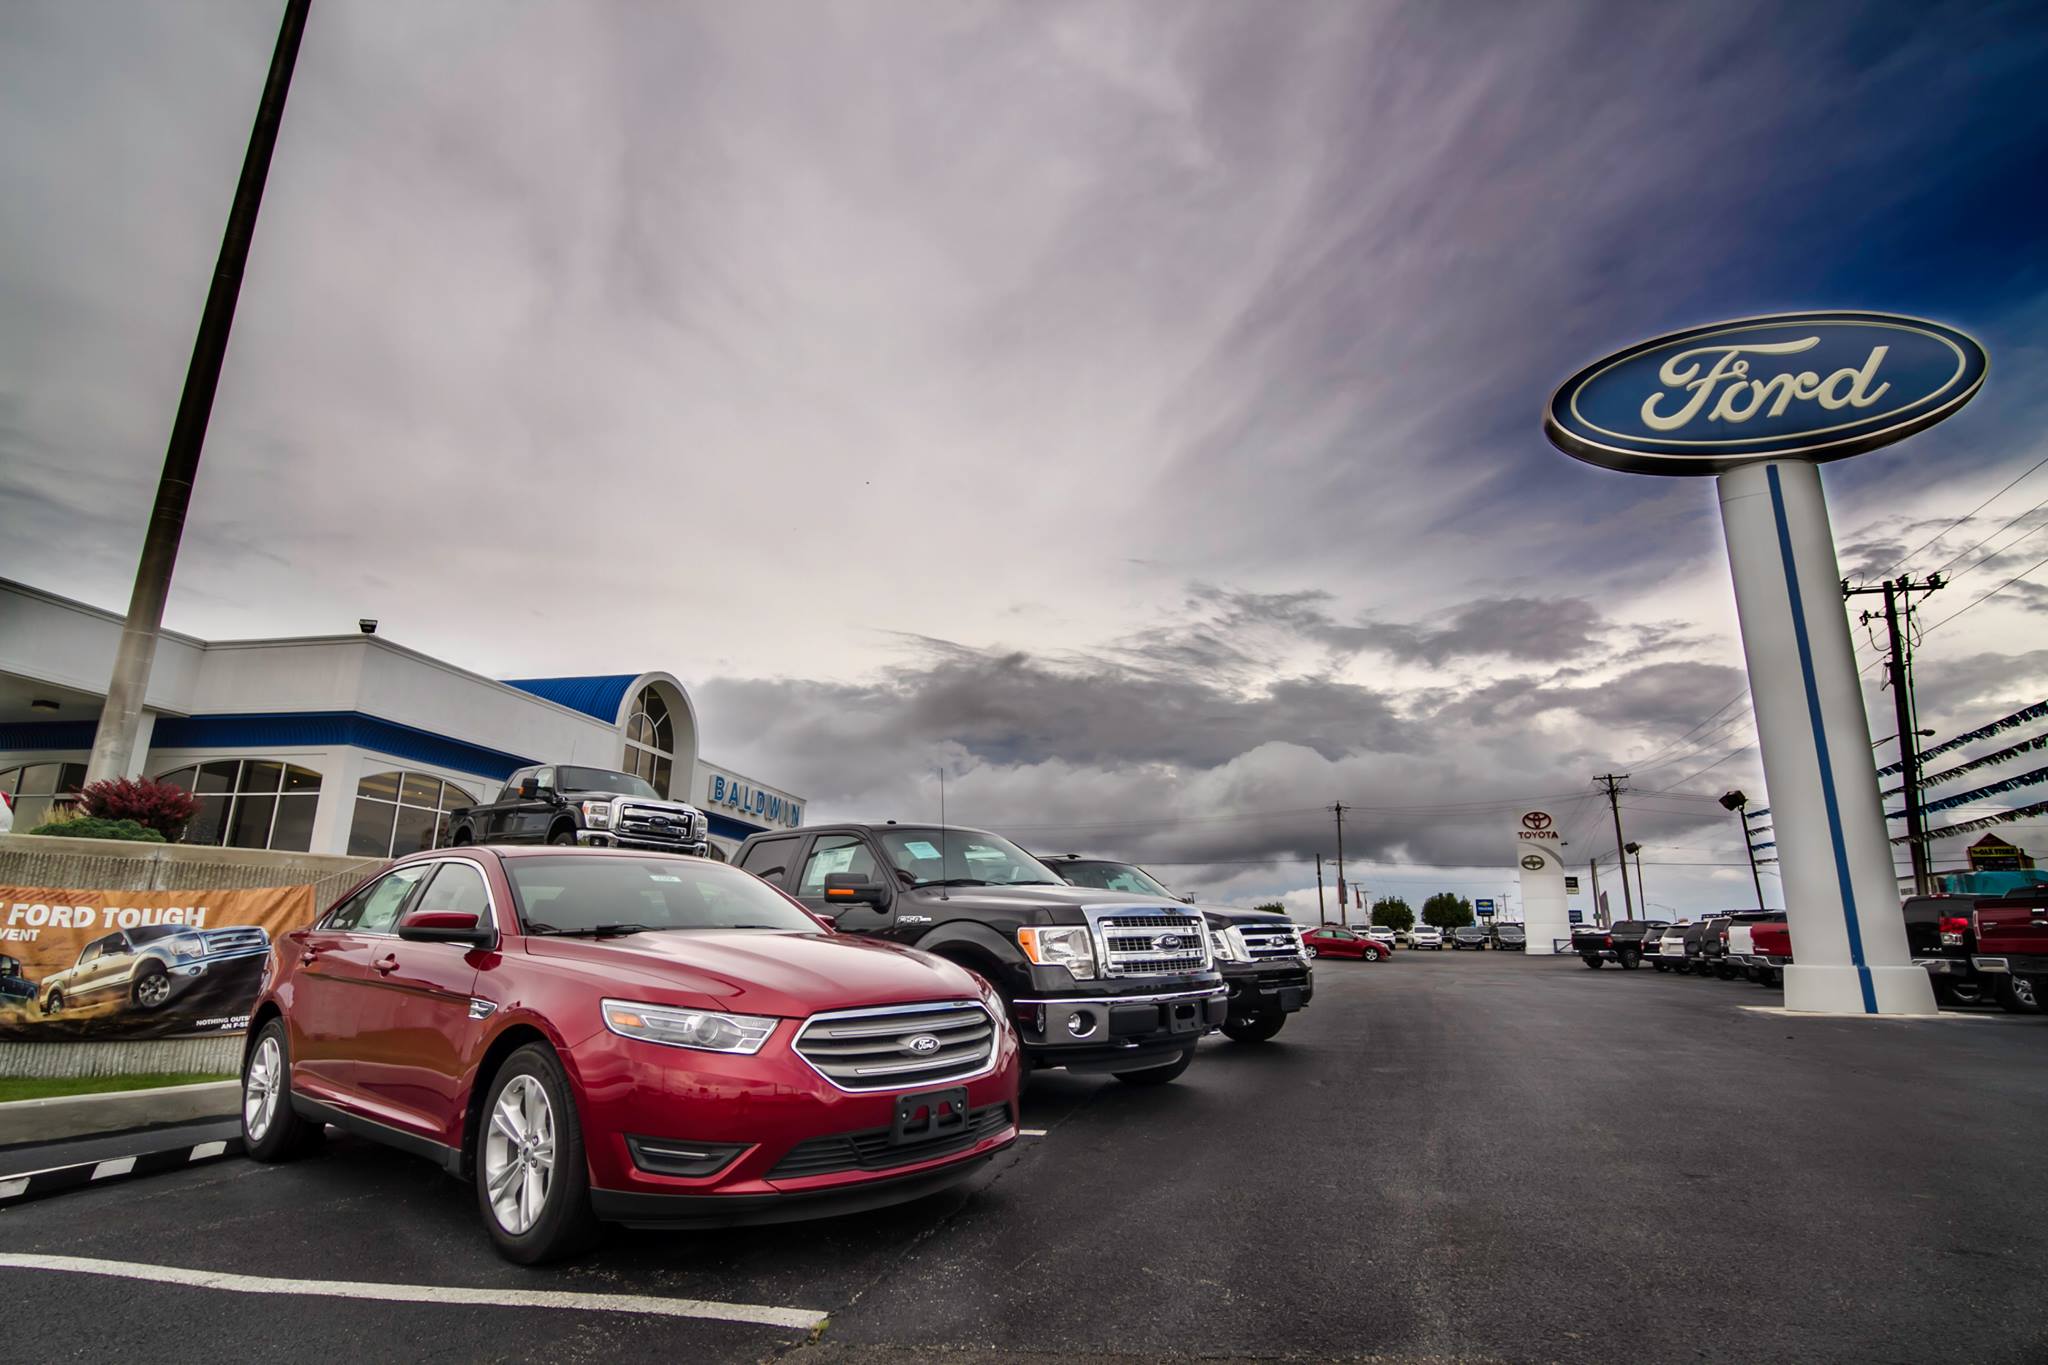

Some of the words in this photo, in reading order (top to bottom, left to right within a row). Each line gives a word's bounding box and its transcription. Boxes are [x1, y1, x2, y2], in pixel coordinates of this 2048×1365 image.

[1641, 336, 1891, 431] Ford
[712, 775, 800, 828] BALDWIN
[1518, 831, 1559, 840] TOYOTA
[7, 903, 96, 928] FORD
[102, 907, 206, 929] TOUGH
[196, 1017, 229, 1026] NOTHING
[918, 1039, 934, 1050] Ford
